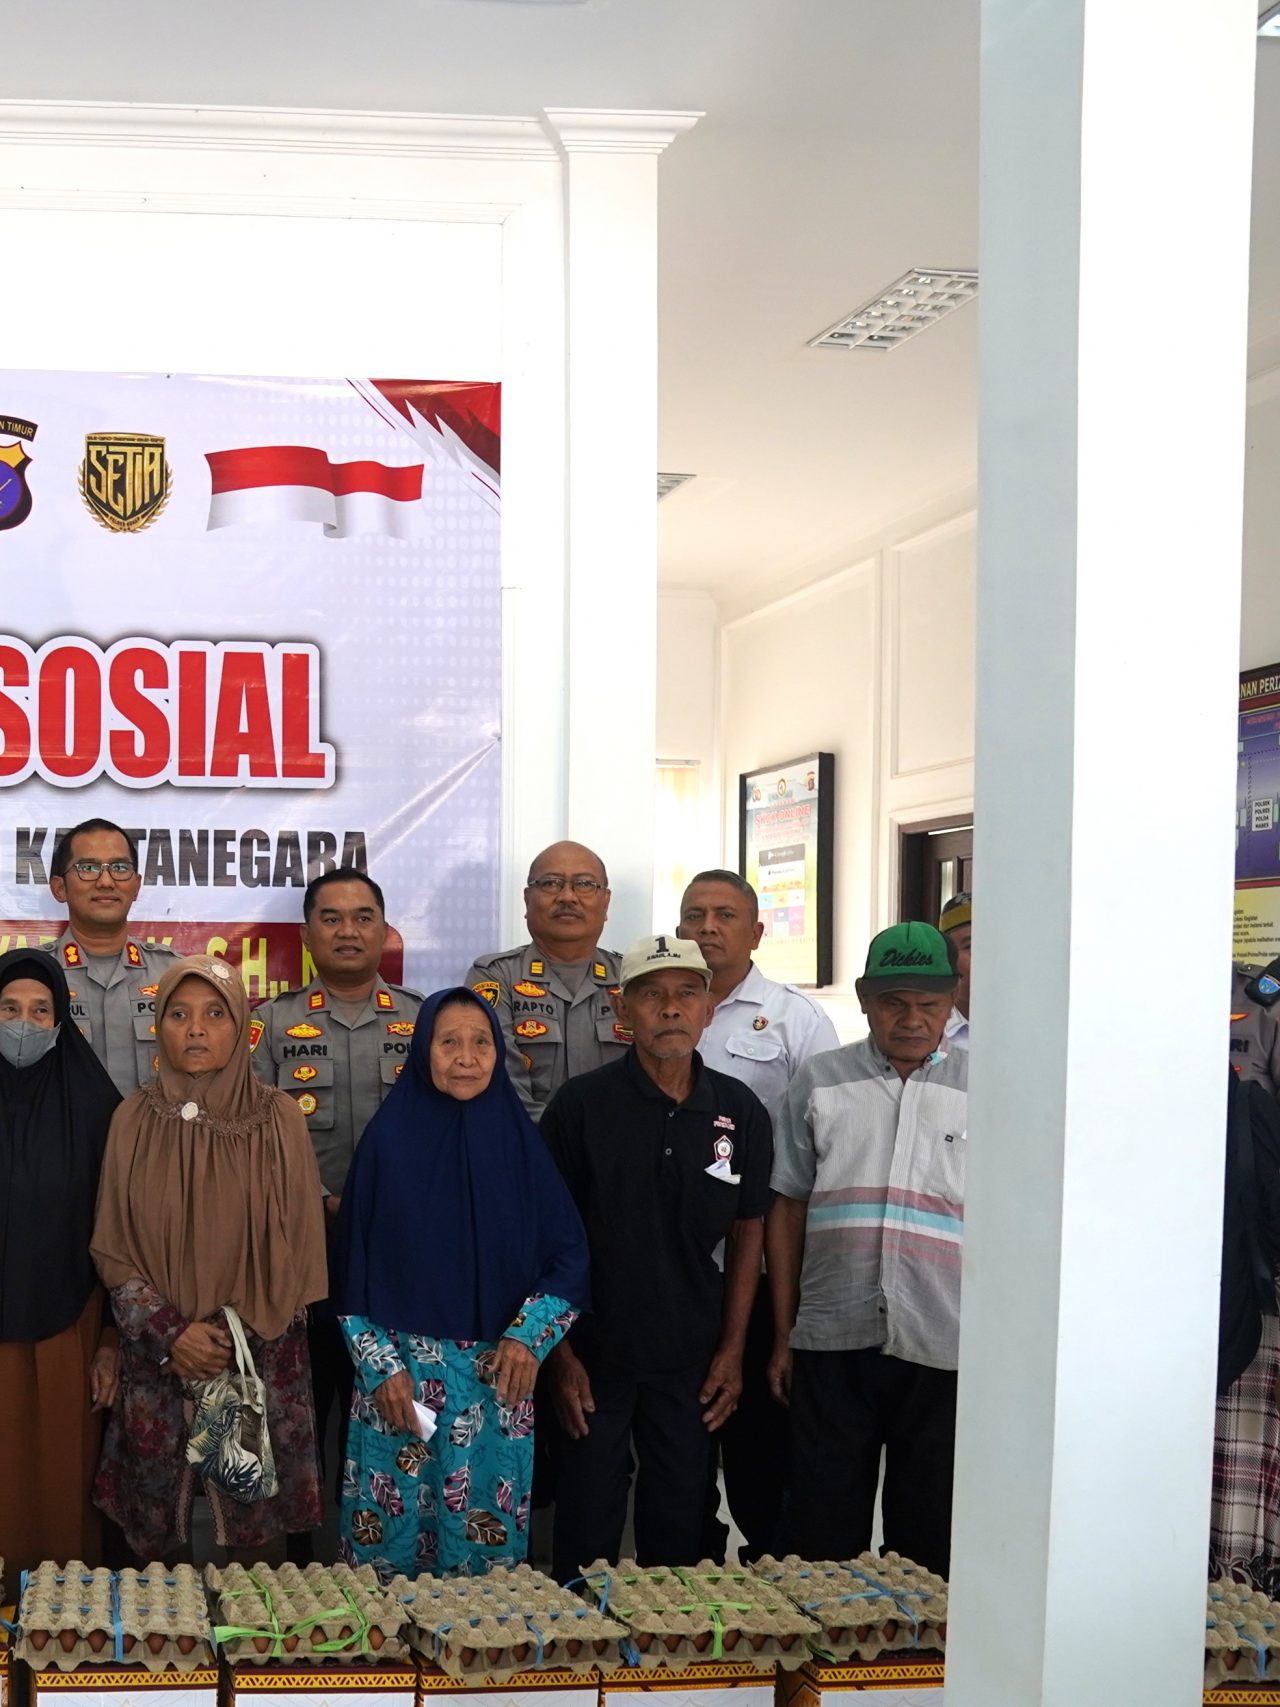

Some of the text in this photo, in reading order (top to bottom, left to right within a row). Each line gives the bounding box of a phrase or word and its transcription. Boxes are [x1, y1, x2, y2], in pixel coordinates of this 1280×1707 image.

[7, 421, 34, 437] TIMUR
[89, 445, 162, 517] SETIA
[1259, 675, 1280, 694] PERI
[655, 936, 669, 953] 1
[879, 947, 934, 967] Dickies
[283, 1044, 328, 1058] HARI
